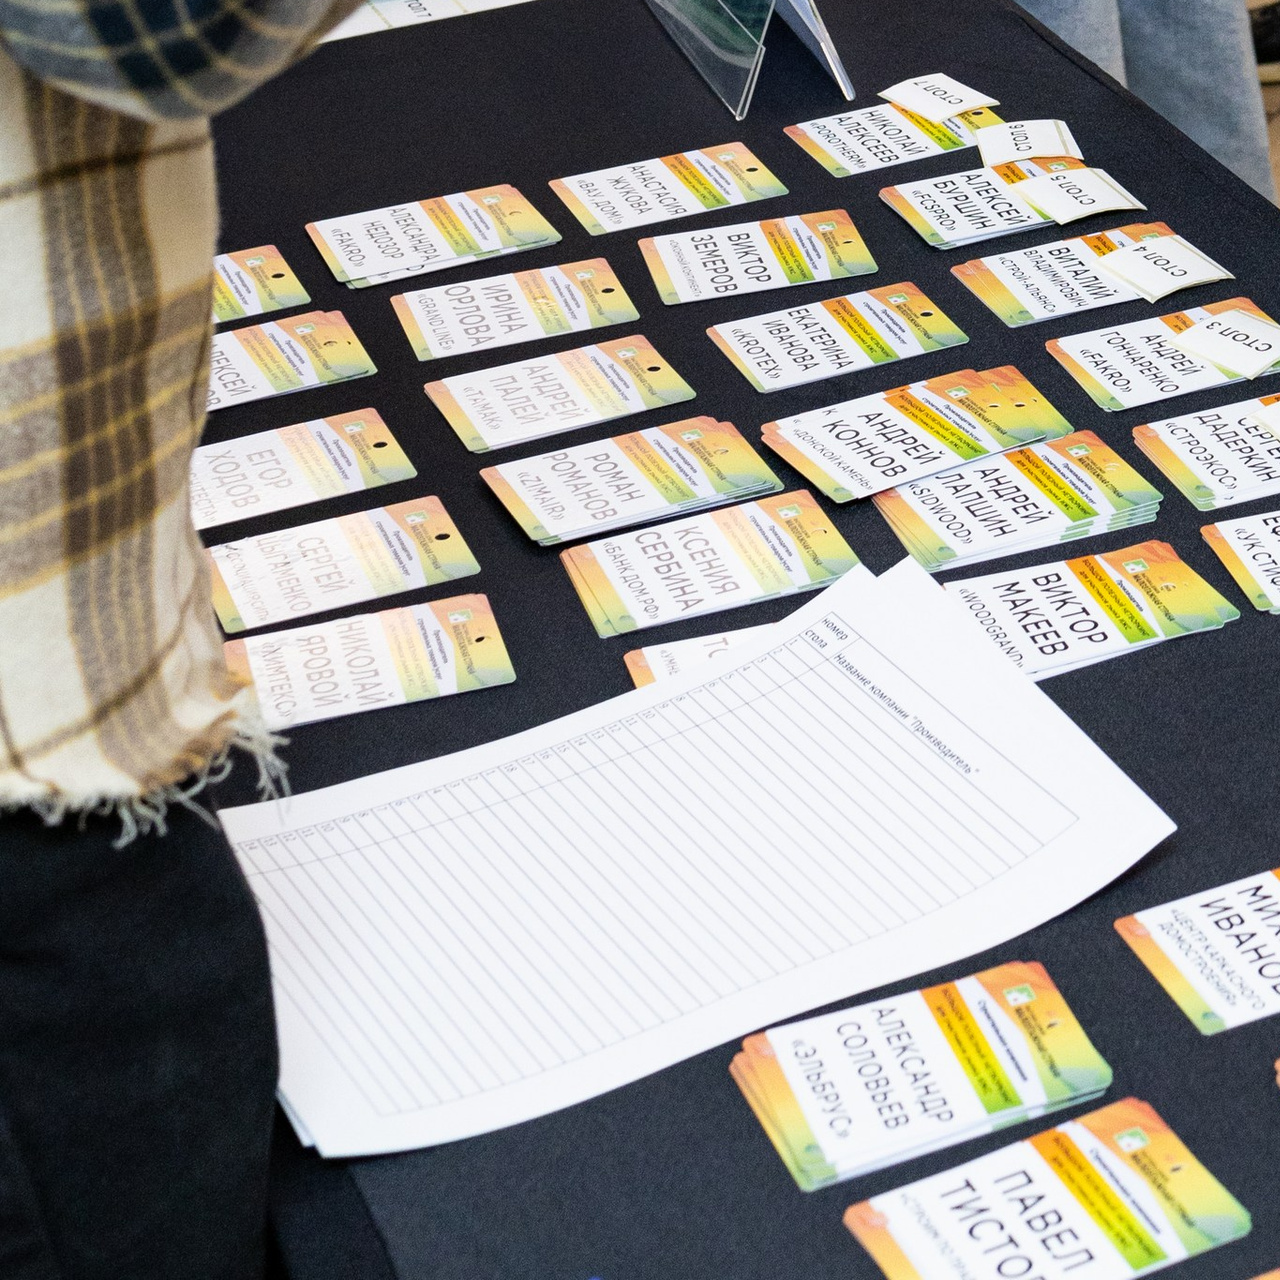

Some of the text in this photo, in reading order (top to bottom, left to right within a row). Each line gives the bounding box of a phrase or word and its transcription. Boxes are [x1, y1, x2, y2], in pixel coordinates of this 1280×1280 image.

[922, 83, 963, 105] СТОЛ
[810, 123, 866, 168] «POROTHERM»
[833, 117, 899, 162] АЛЕКСЕЕВ
[861, 110, 928, 155] НИКОЛАЙ
[1010, 130, 1033, 152] СТОЛ
[607, 176, 652, 215] ЖУКОВА
[628, 166, 687, 215] АНАСТАСИЯ
[912, 191, 955, 230] «FCSPRO»
[933, 180, 995, 229] БУРШИН
[961, 175, 1030, 225] АЛЕКСЕЙ
[1058, 181, 1096, 206] СТОЛ
[332, 229, 365, 266] «FAKRO»
[363, 221, 404, 258] НЕДОЗОР
[391, 208, 440, 261] АЛЕКСАНДРА
[728, 233, 771, 282] ВИКТОР
[691, 235, 738, 293] ЗЕМЕРОВ
[999, 257, 1055, 312] «СТРОЙ-АЛЬЯНС»
[1024, 250, 1088, 307] ВЛАДИМИРОВИЧ
[1048, 247, 1117, 299] ВИТАЛИЙ
[1143, 251, 1188, 277] СТОЛ
[418, 294, 455, 350] «GRAND LINE»
[444, 286, 495, 346] ОРЛОВА
[481, 284, 528, 334] ИРИНА
[732, 329, 782, 378] «KROTEX»
[763, 320, 819, 371] ИВАНОВА
[788, 308, 854, 369] ЕКАТЕРИНА
[1101, 332, 1179, 392] ГОНЧАРЕНКО
[1140, 335, 1204, 375] АНДРЕЙ
[1205, 321, 1273, 353] 3 СТОЛ
[211, 344, 257, 398] ЛЕКСЕЙ
[522, 366, 589, 420] АНДРЕЙ
[1080, 350, 1131, 392] «FAKRO»
[464, 387, 502, 429] «ТАМАК»
[489, 375, 549, 424] ПАЛЕЙ
[794, 430, 872, 489] «ДОНСКОЙ КАМЕНЬ»
[823, 420, 907, 477] КОННОВ
[858, 413, 944, 464] АНДРЕЙ
[1166, 423, 1237, 489] «СТРОЭКОС»
[1194, 414, 1280, 481] ДАДЕРКИН
[204, 450, 260, 507] ХОДОВ
[246, 449, 293, 488] ЕГОР
[542, 452, 617, 520] РОМАНОВ
[585, 453, 645, 502] РОМАН
[517, 472, 565, 520] «ZIMAIR»
[903, 483, 972, 543] «SIDWOOD»
[935, 473, 1017, 537] ЛАПШИН
[974, 469, 1052, 524] АНДРЕЙ
[297, 538, 355, 593] СЕРГЕЙ
[674, 526, 740, 595] КСЕНИЯ
[1235, 529, 1264, 551] «УК
[603, 542, 659, 619] «БАНК ДОМ.РФ»
[635, 532, 704, 611] СЕРБИНА
[823, 617, 849, 641] номер
[993, 582, 1068, 655] МАКЕЕВ
[1032, 573, 1108, 642] ВИКТОР
[336, 621, 394, 706] НИКОЛАЙ
[804, 629, 828, 649] стола
[296, 636, 350, 708] ЯРОВОЙ
[833, 652, 872, 687] Название
[868, 683, 910, 720] компании
[793, 1040, 852, 1137] «ЭЛЬБРУС»
[837, 1024, 909, 1128] СОЛОВЬЕВ
[877, 1009, 953, 1120] АЛЕКСАНДР
[941, 1179, 1046, 1280] ТИСТО
[994, 1170, 1094, 1272] ПАВЕЛ
